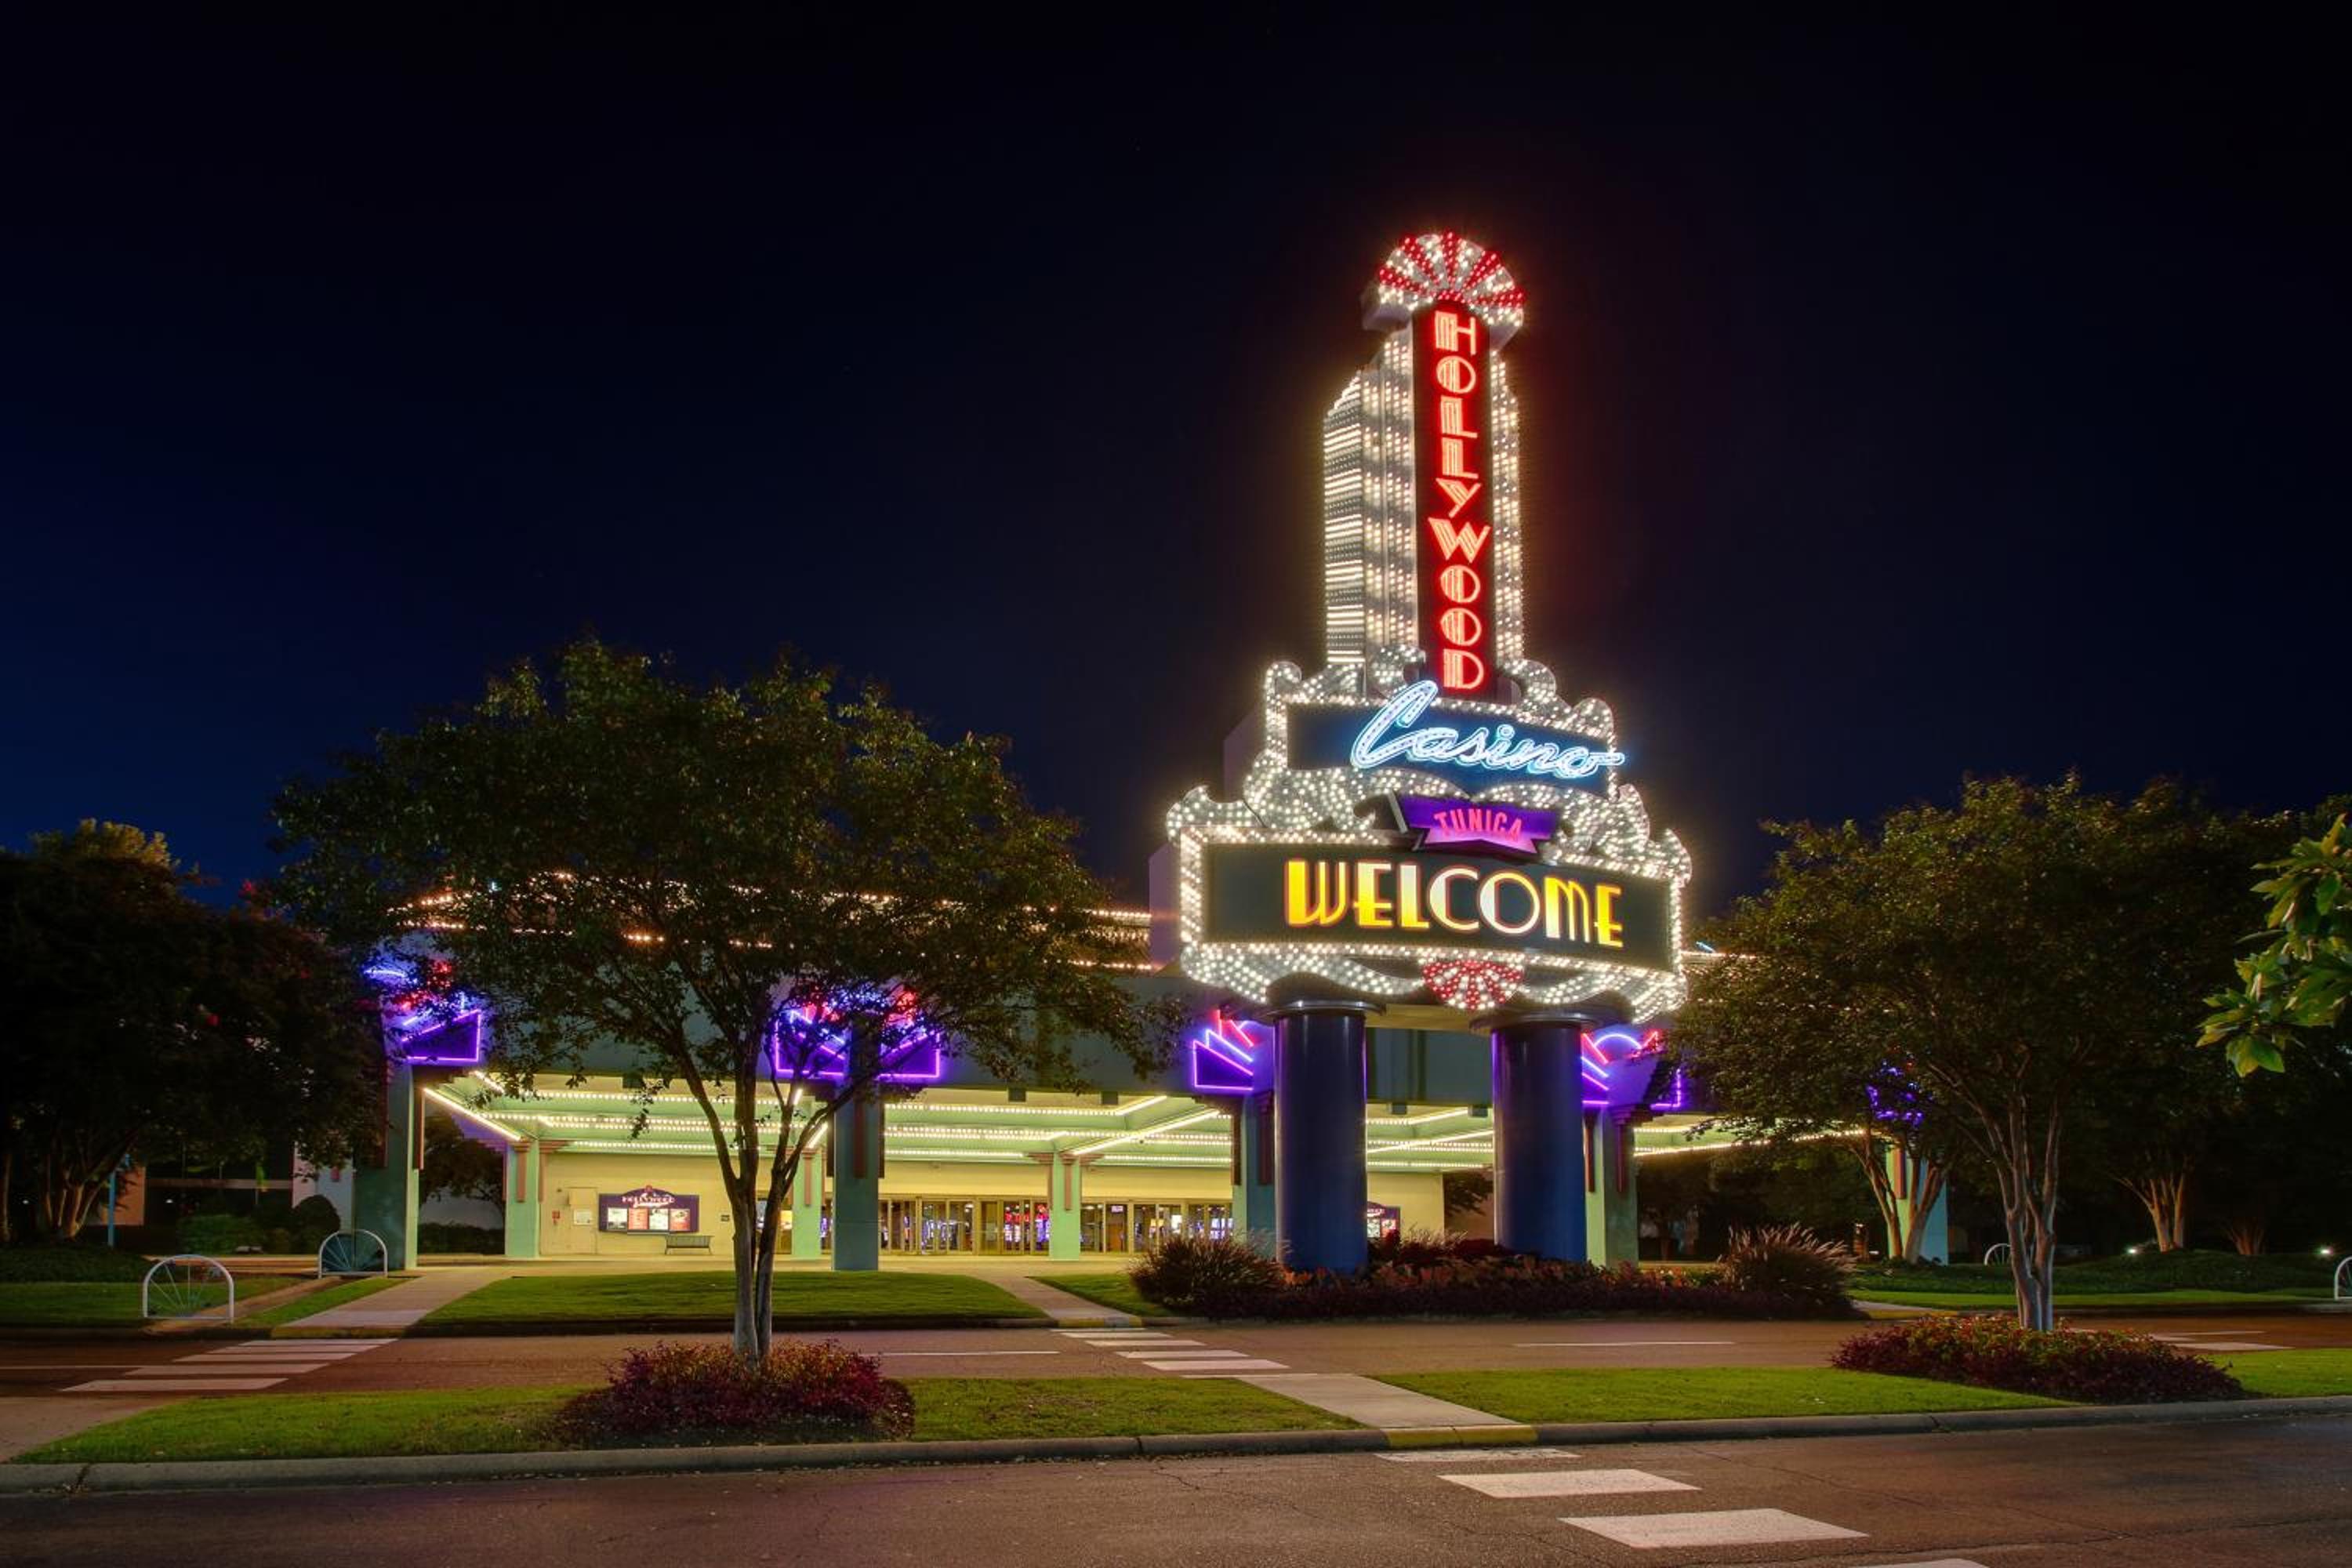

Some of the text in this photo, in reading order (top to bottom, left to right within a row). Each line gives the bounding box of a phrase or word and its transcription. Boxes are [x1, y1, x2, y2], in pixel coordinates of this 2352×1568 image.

[1428, 310, 1490, 690] HOLLYWOOD
[1351, 680, 1624, 779] Casino
[1433, 808, 1523, 841] TUNICA
[1285, 858, 1625, 949] WELCOME
